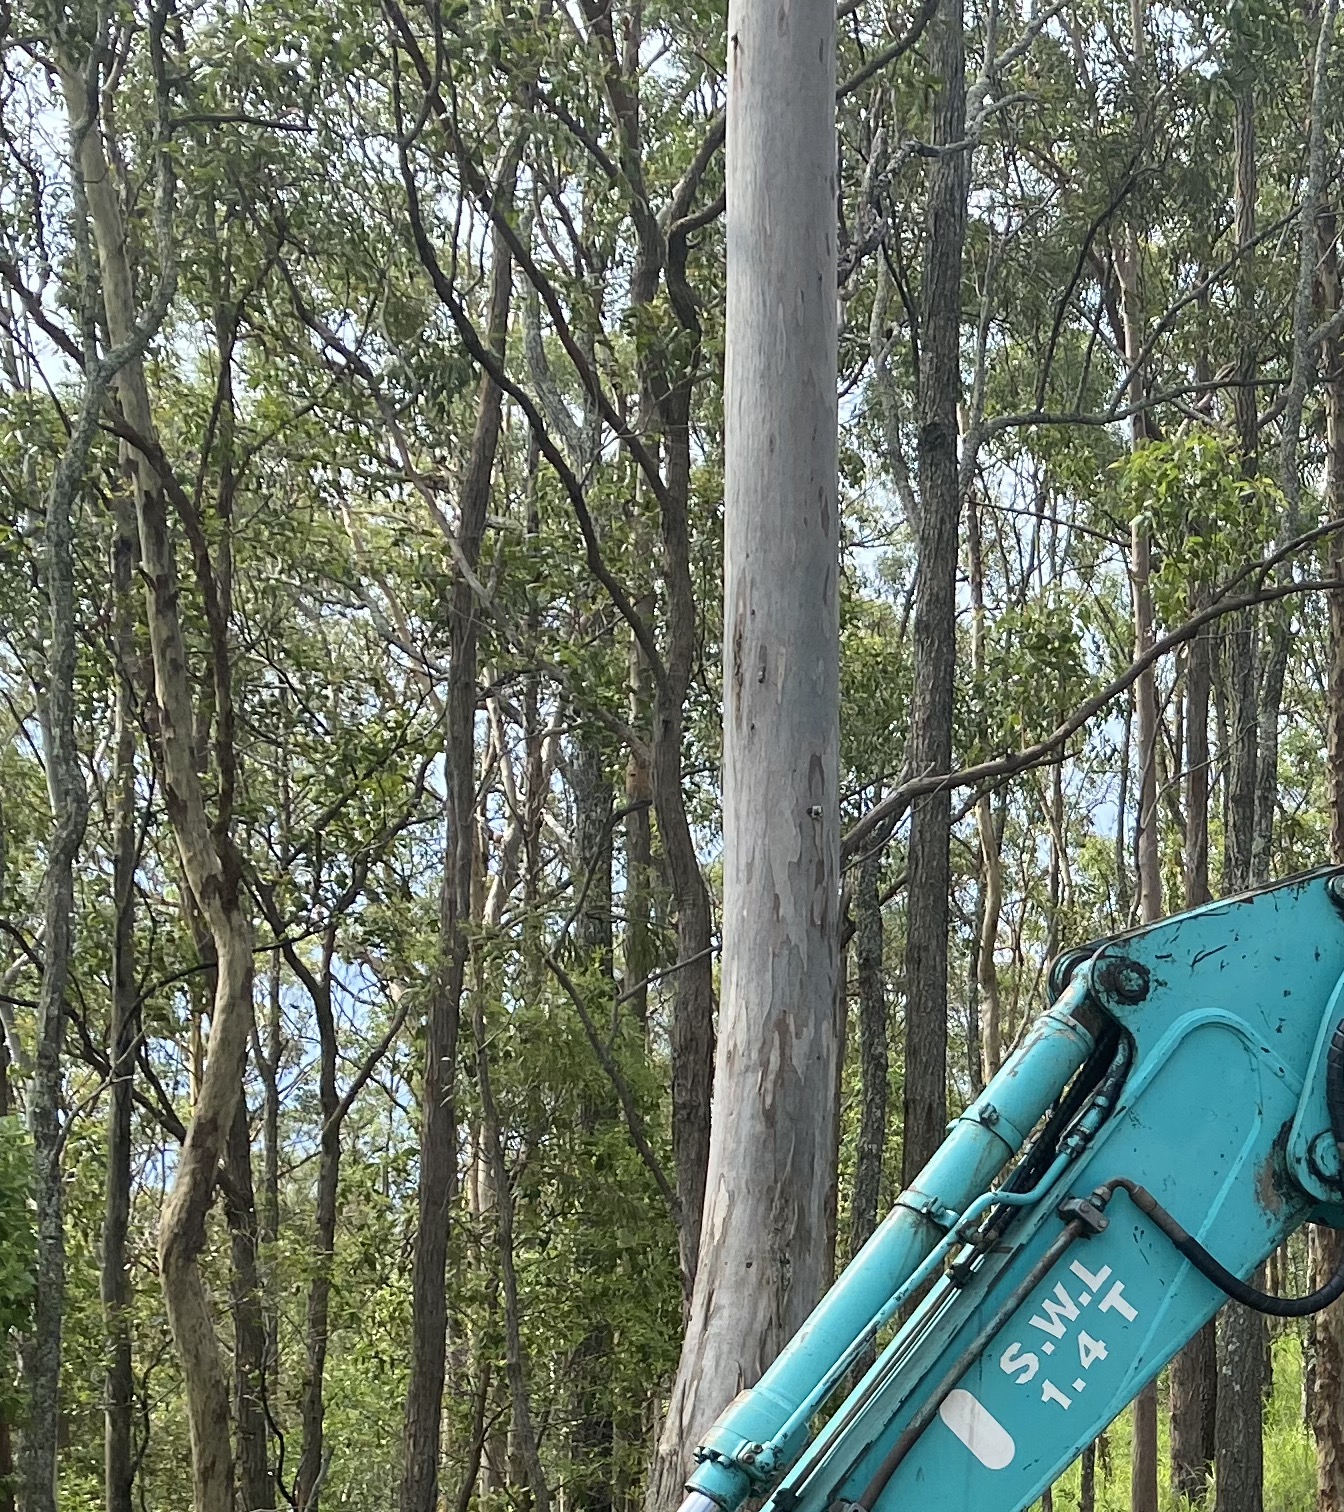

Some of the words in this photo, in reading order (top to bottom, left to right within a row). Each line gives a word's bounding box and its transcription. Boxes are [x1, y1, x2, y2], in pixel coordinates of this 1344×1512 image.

[1000, 1259, 1112, 1385] S.W.L
[1041, 1330, 1109, 1410] 1.4
[1098, 1280, 1139, 1323] T
